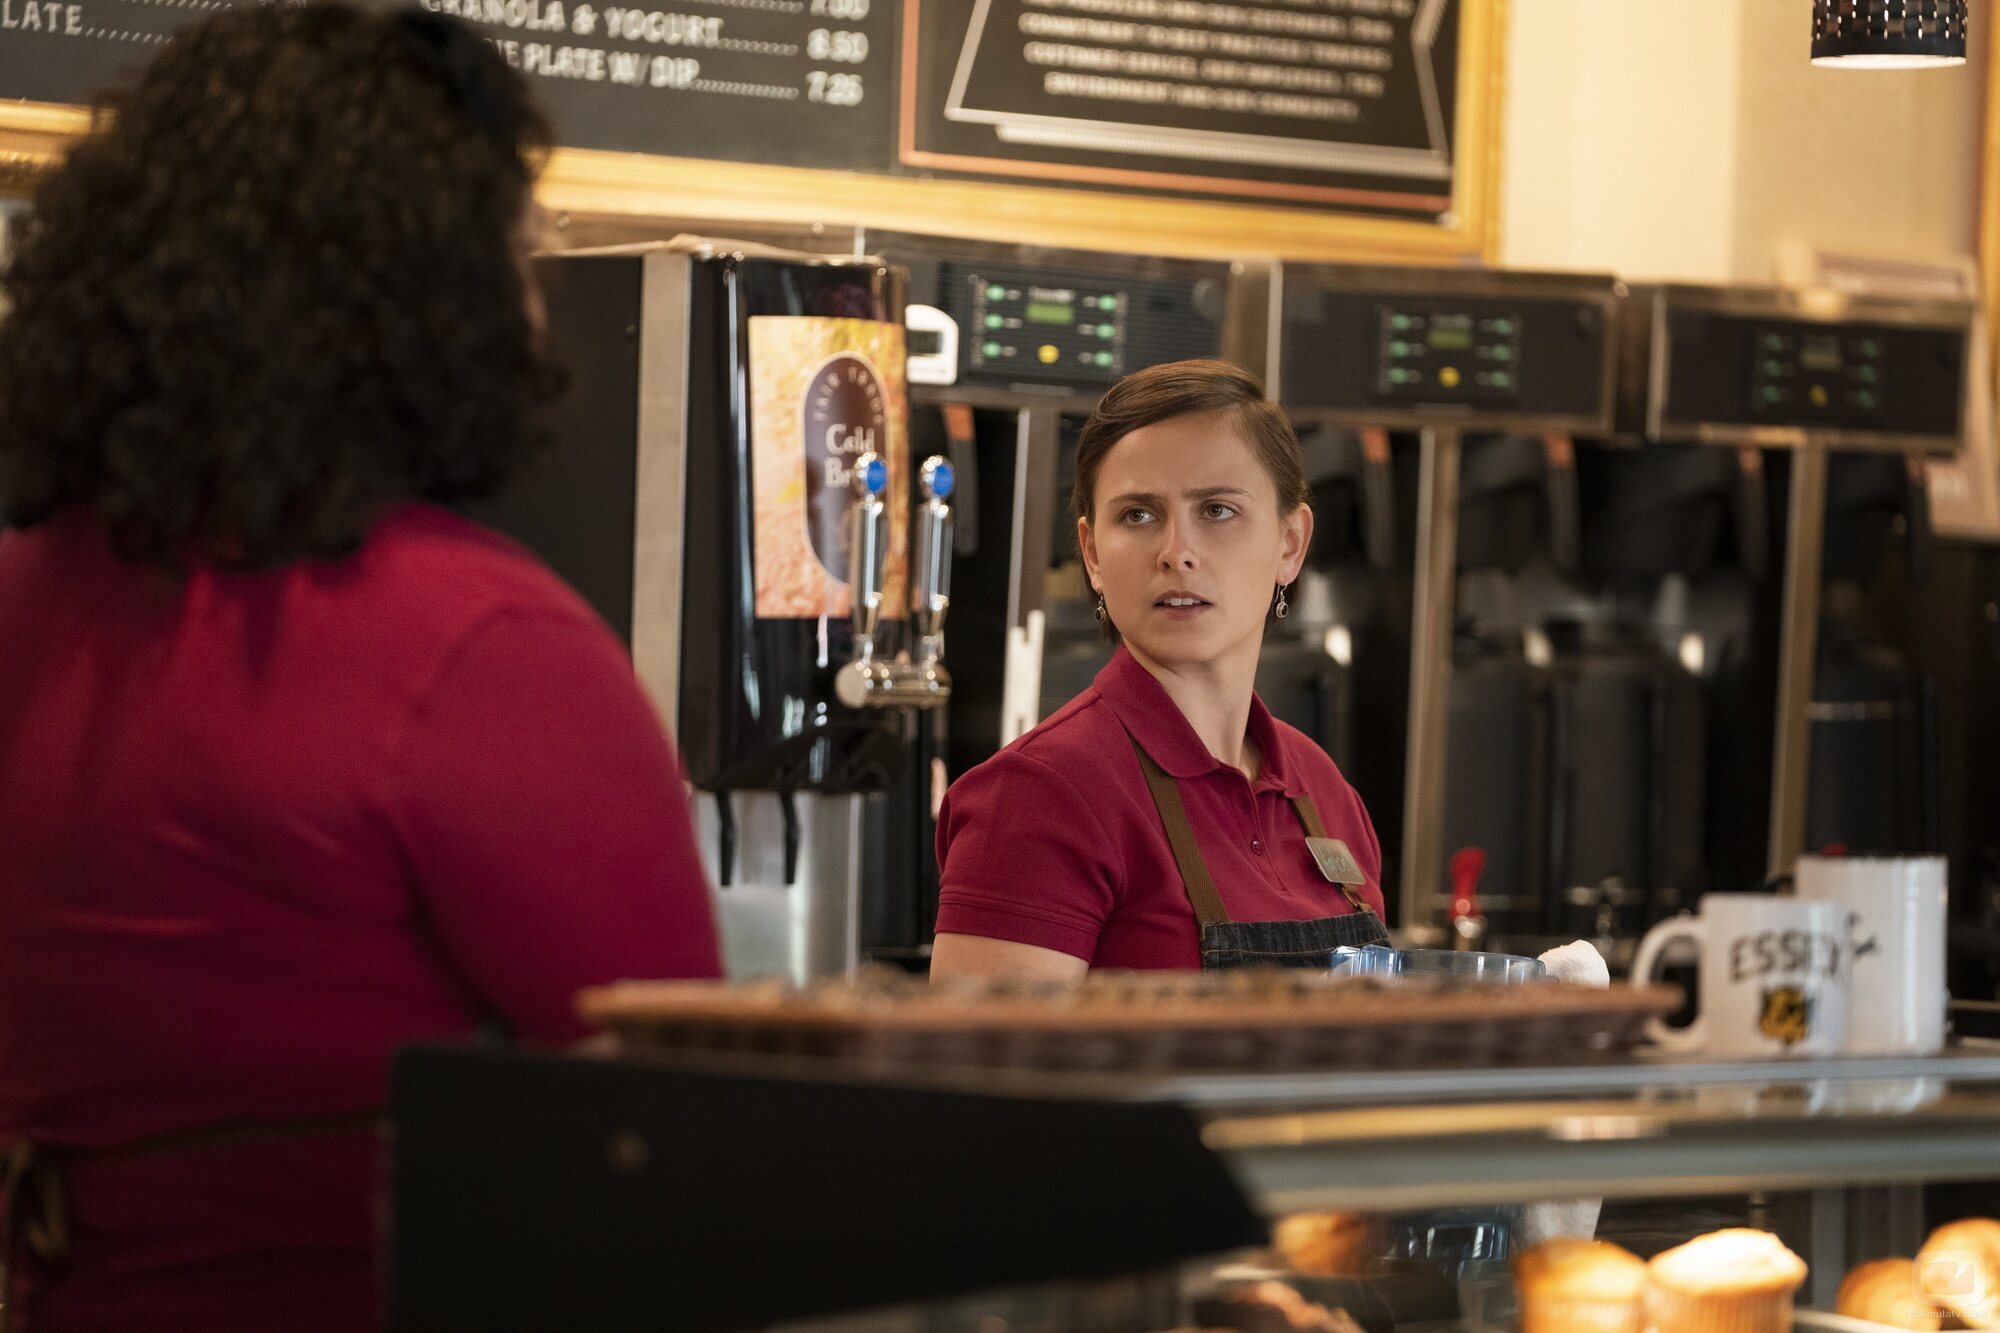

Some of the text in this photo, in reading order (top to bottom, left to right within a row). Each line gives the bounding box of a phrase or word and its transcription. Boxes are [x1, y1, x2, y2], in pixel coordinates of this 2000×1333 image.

[571, 4, 599, 35] &
[603, 6, 725, 49] YOGURT
[523, 42, 607, 82] PLATE
[825, 423, 875, 456] Cold
